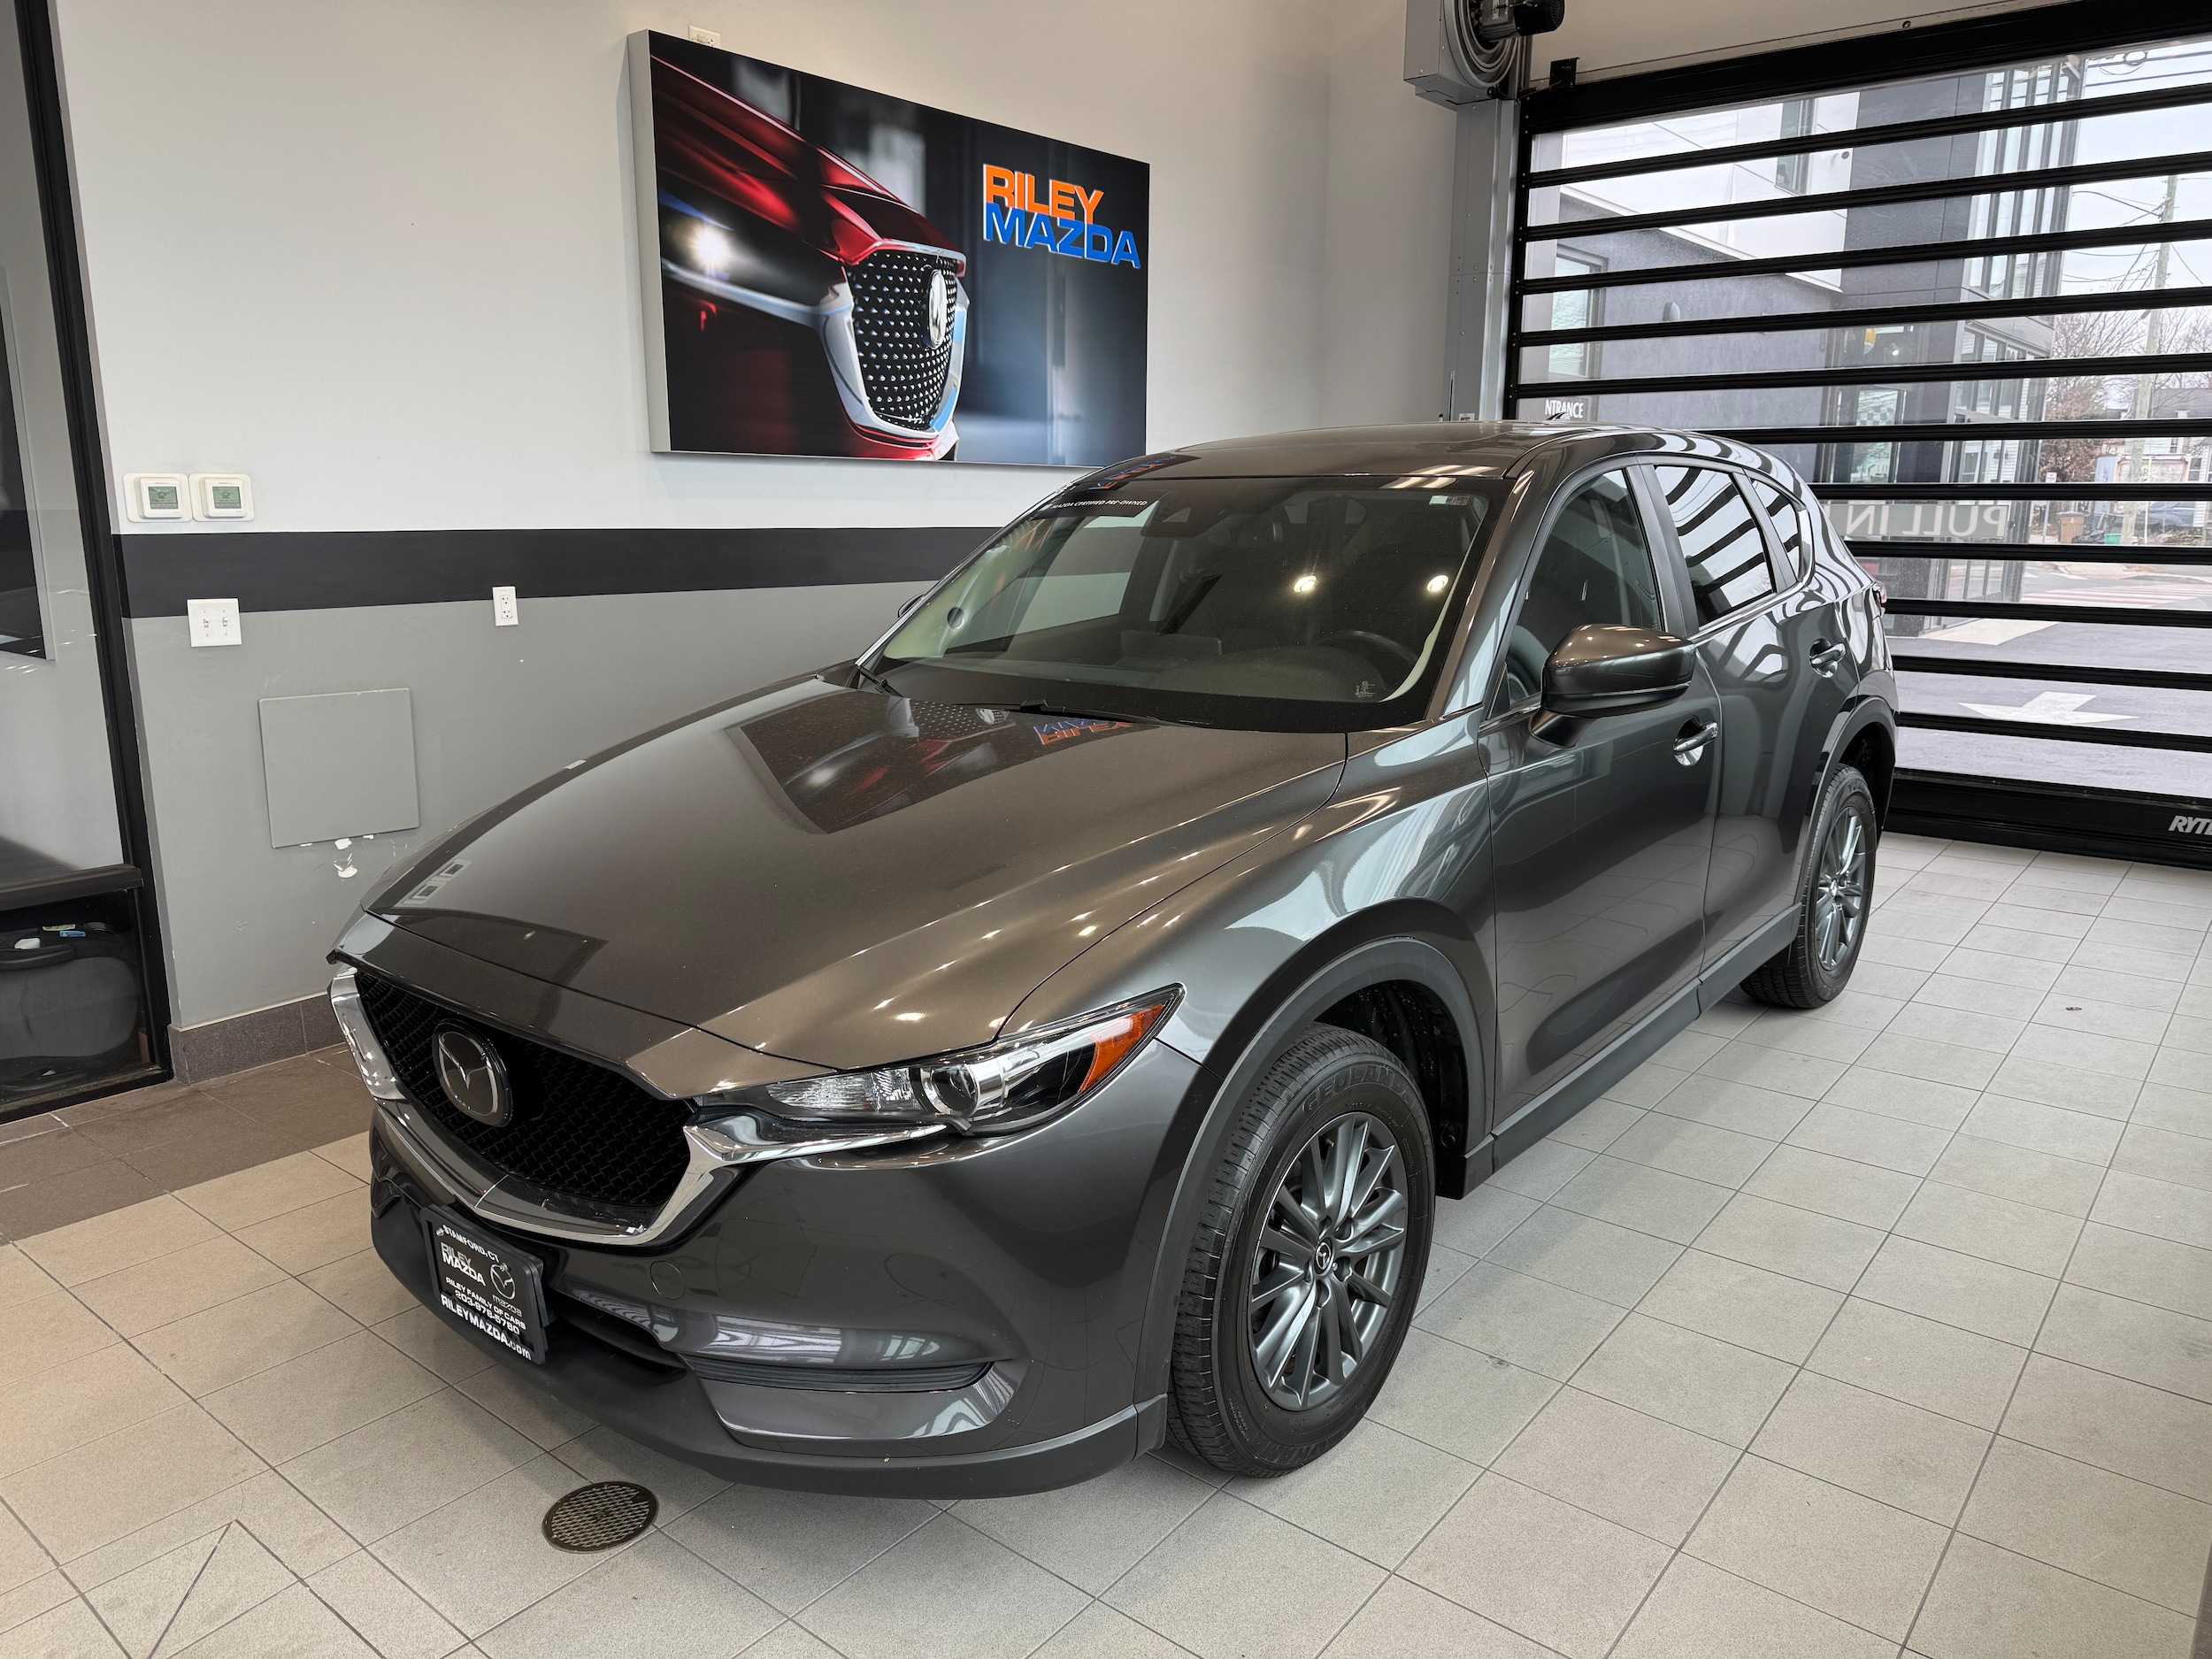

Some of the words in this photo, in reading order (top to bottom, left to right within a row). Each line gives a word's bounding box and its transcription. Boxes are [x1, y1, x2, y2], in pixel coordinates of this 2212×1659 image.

[983, 164, 1104, 225] RILEY
[983, 202, 1141, 269] MAZDA
[441, 1241, 472, 1267] RILEY
[442, 1250, 486, 1286] MAZDA
[445, 1276, 466, 1292] RILEY
[466, 1287, 493, 1310] FAMILY
[493, 1306, 504, 1317] OF
[503, 1311, 526, 1331] CARS
